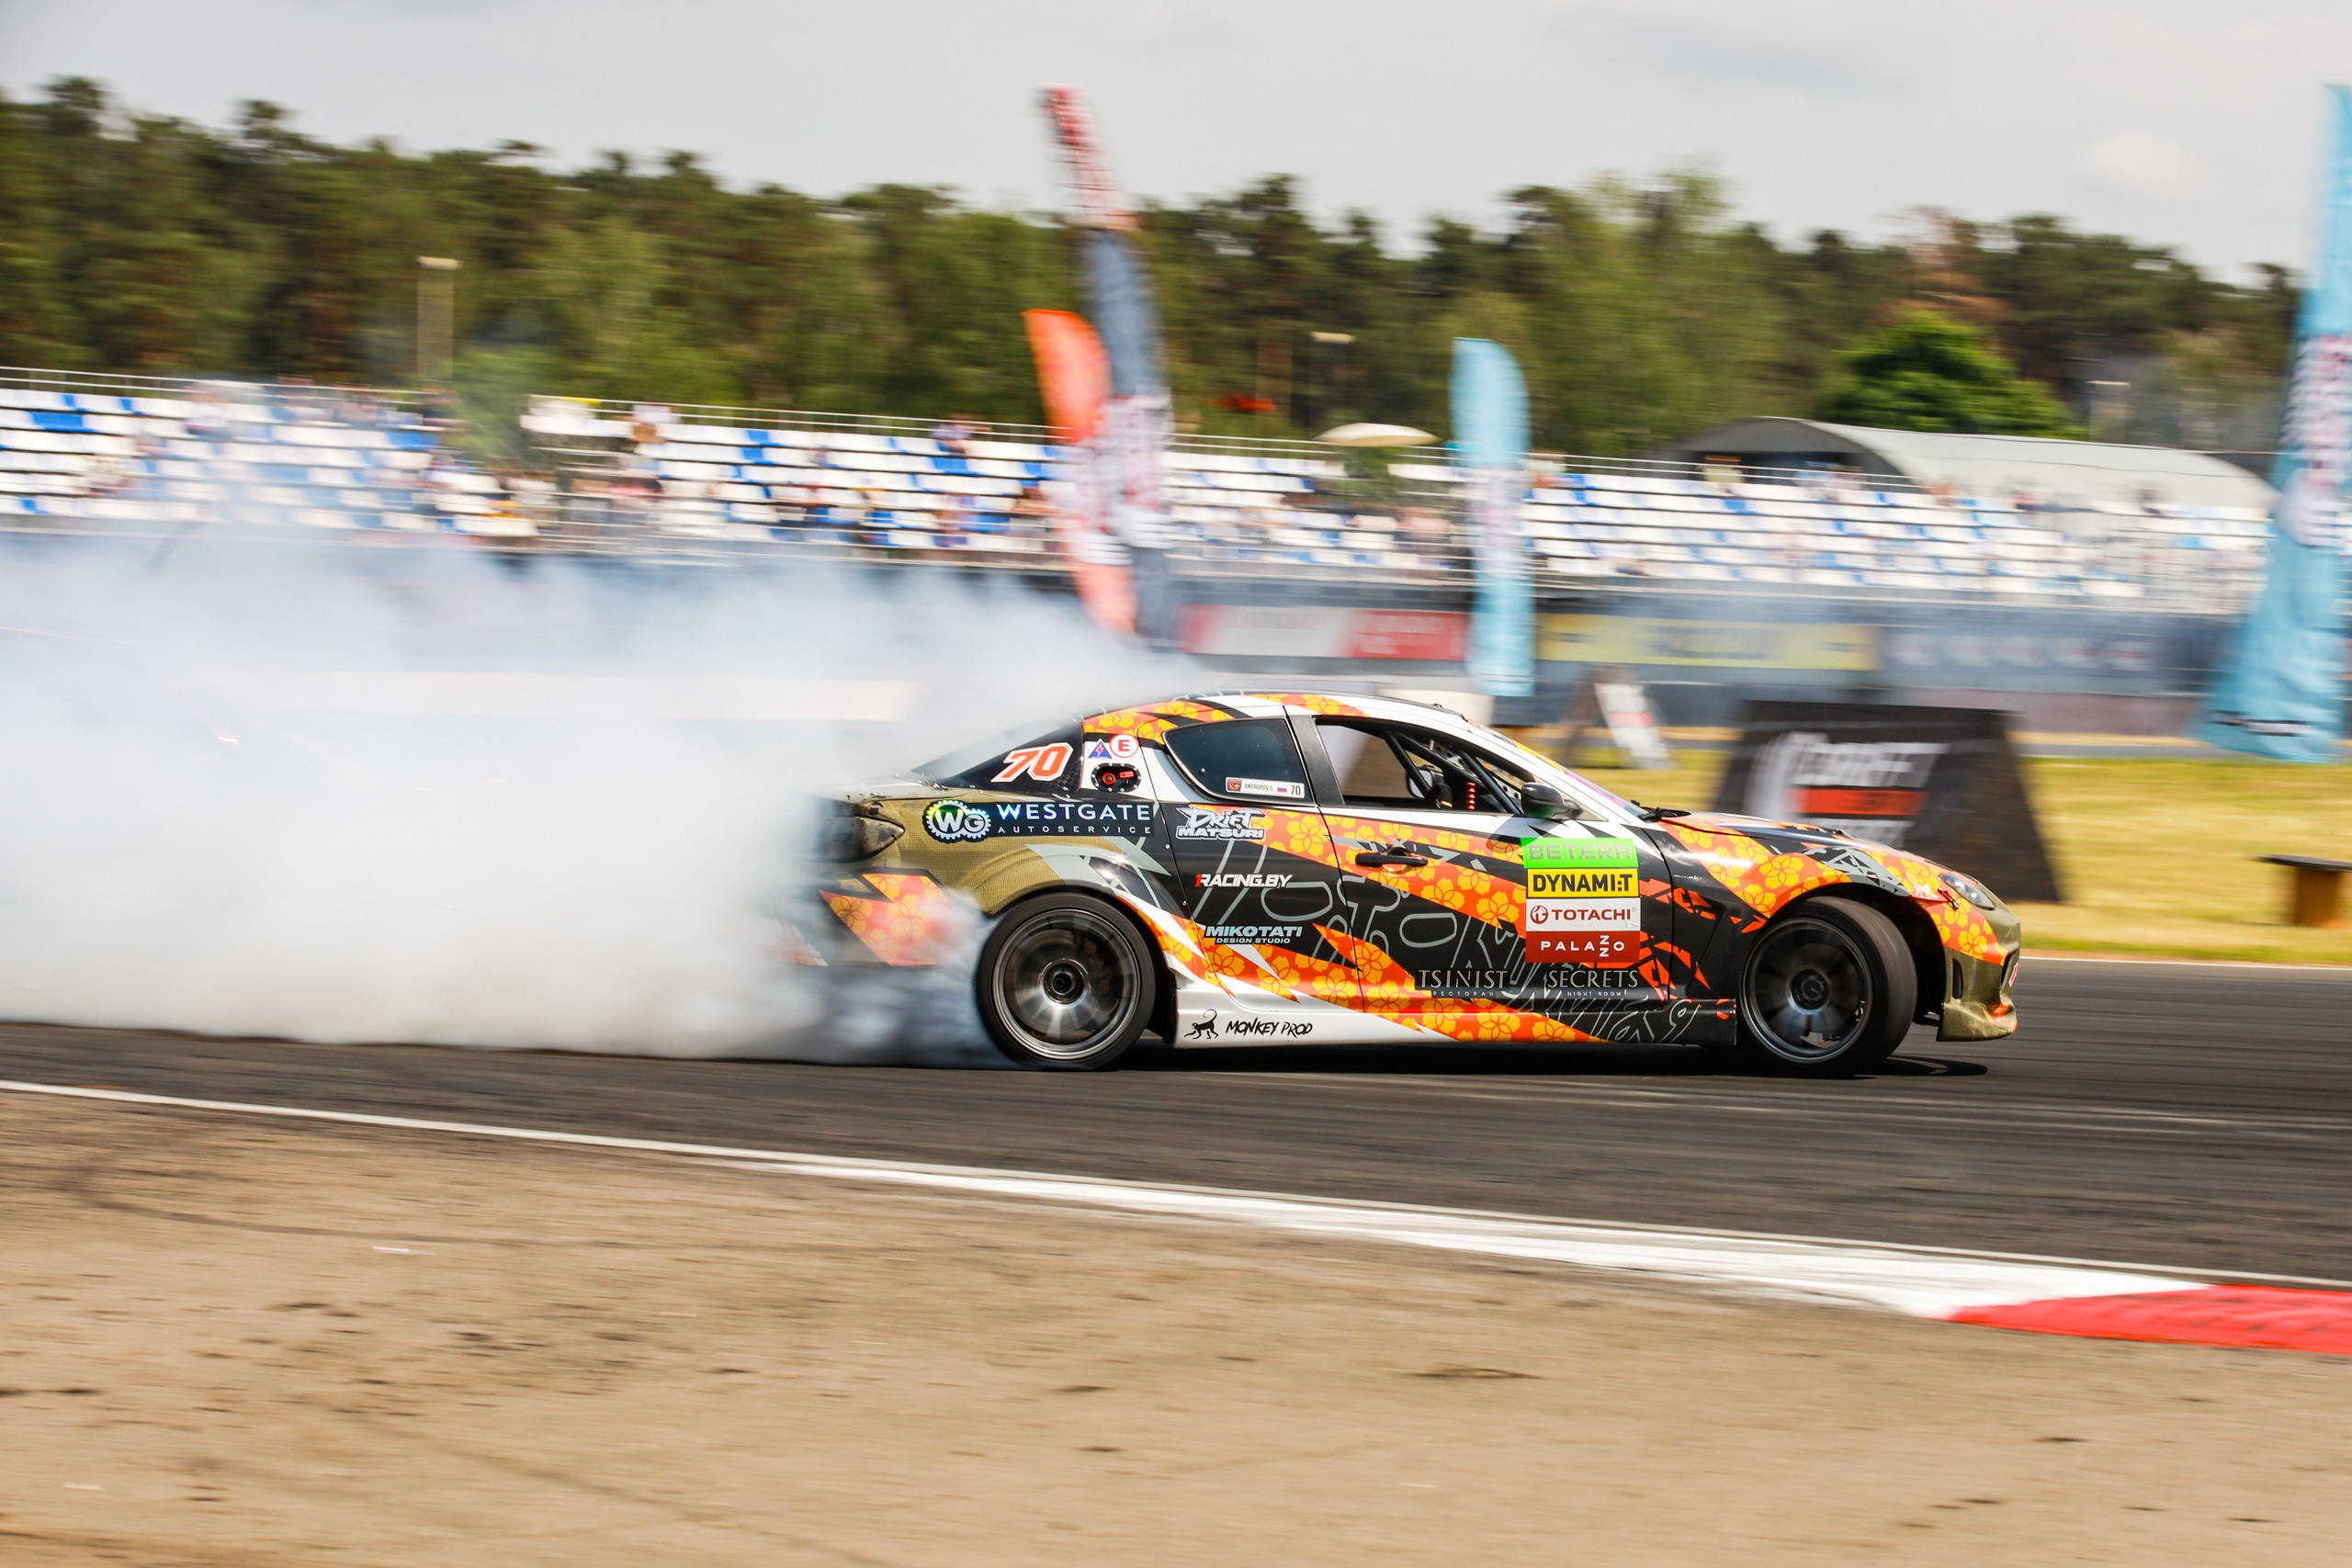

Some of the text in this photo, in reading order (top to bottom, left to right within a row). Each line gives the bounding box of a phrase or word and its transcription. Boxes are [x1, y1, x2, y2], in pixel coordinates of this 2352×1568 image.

[1117, 739, 1131, 752] E
[990, 741, 1074, 784] 70
[1244, 783, 1269, 791] ANTROPOV
[1290, 784, 1301, 795] 70
[997, 803, 1152, 821] WESTGATE
[934, 808, 986, 833] WG
[997, 825, 1152, 835] AUTOSERVICE
[1178, 827, 1265, 840] MATSURI
[1205, 925, 1303, 937] MIKOTATI
[1418, 969, 1509, 989] TSINIST
[1547, 968, 1639, 989] SECRETS
[1225, 1017, 1314, 1039] MONKEY PROD
